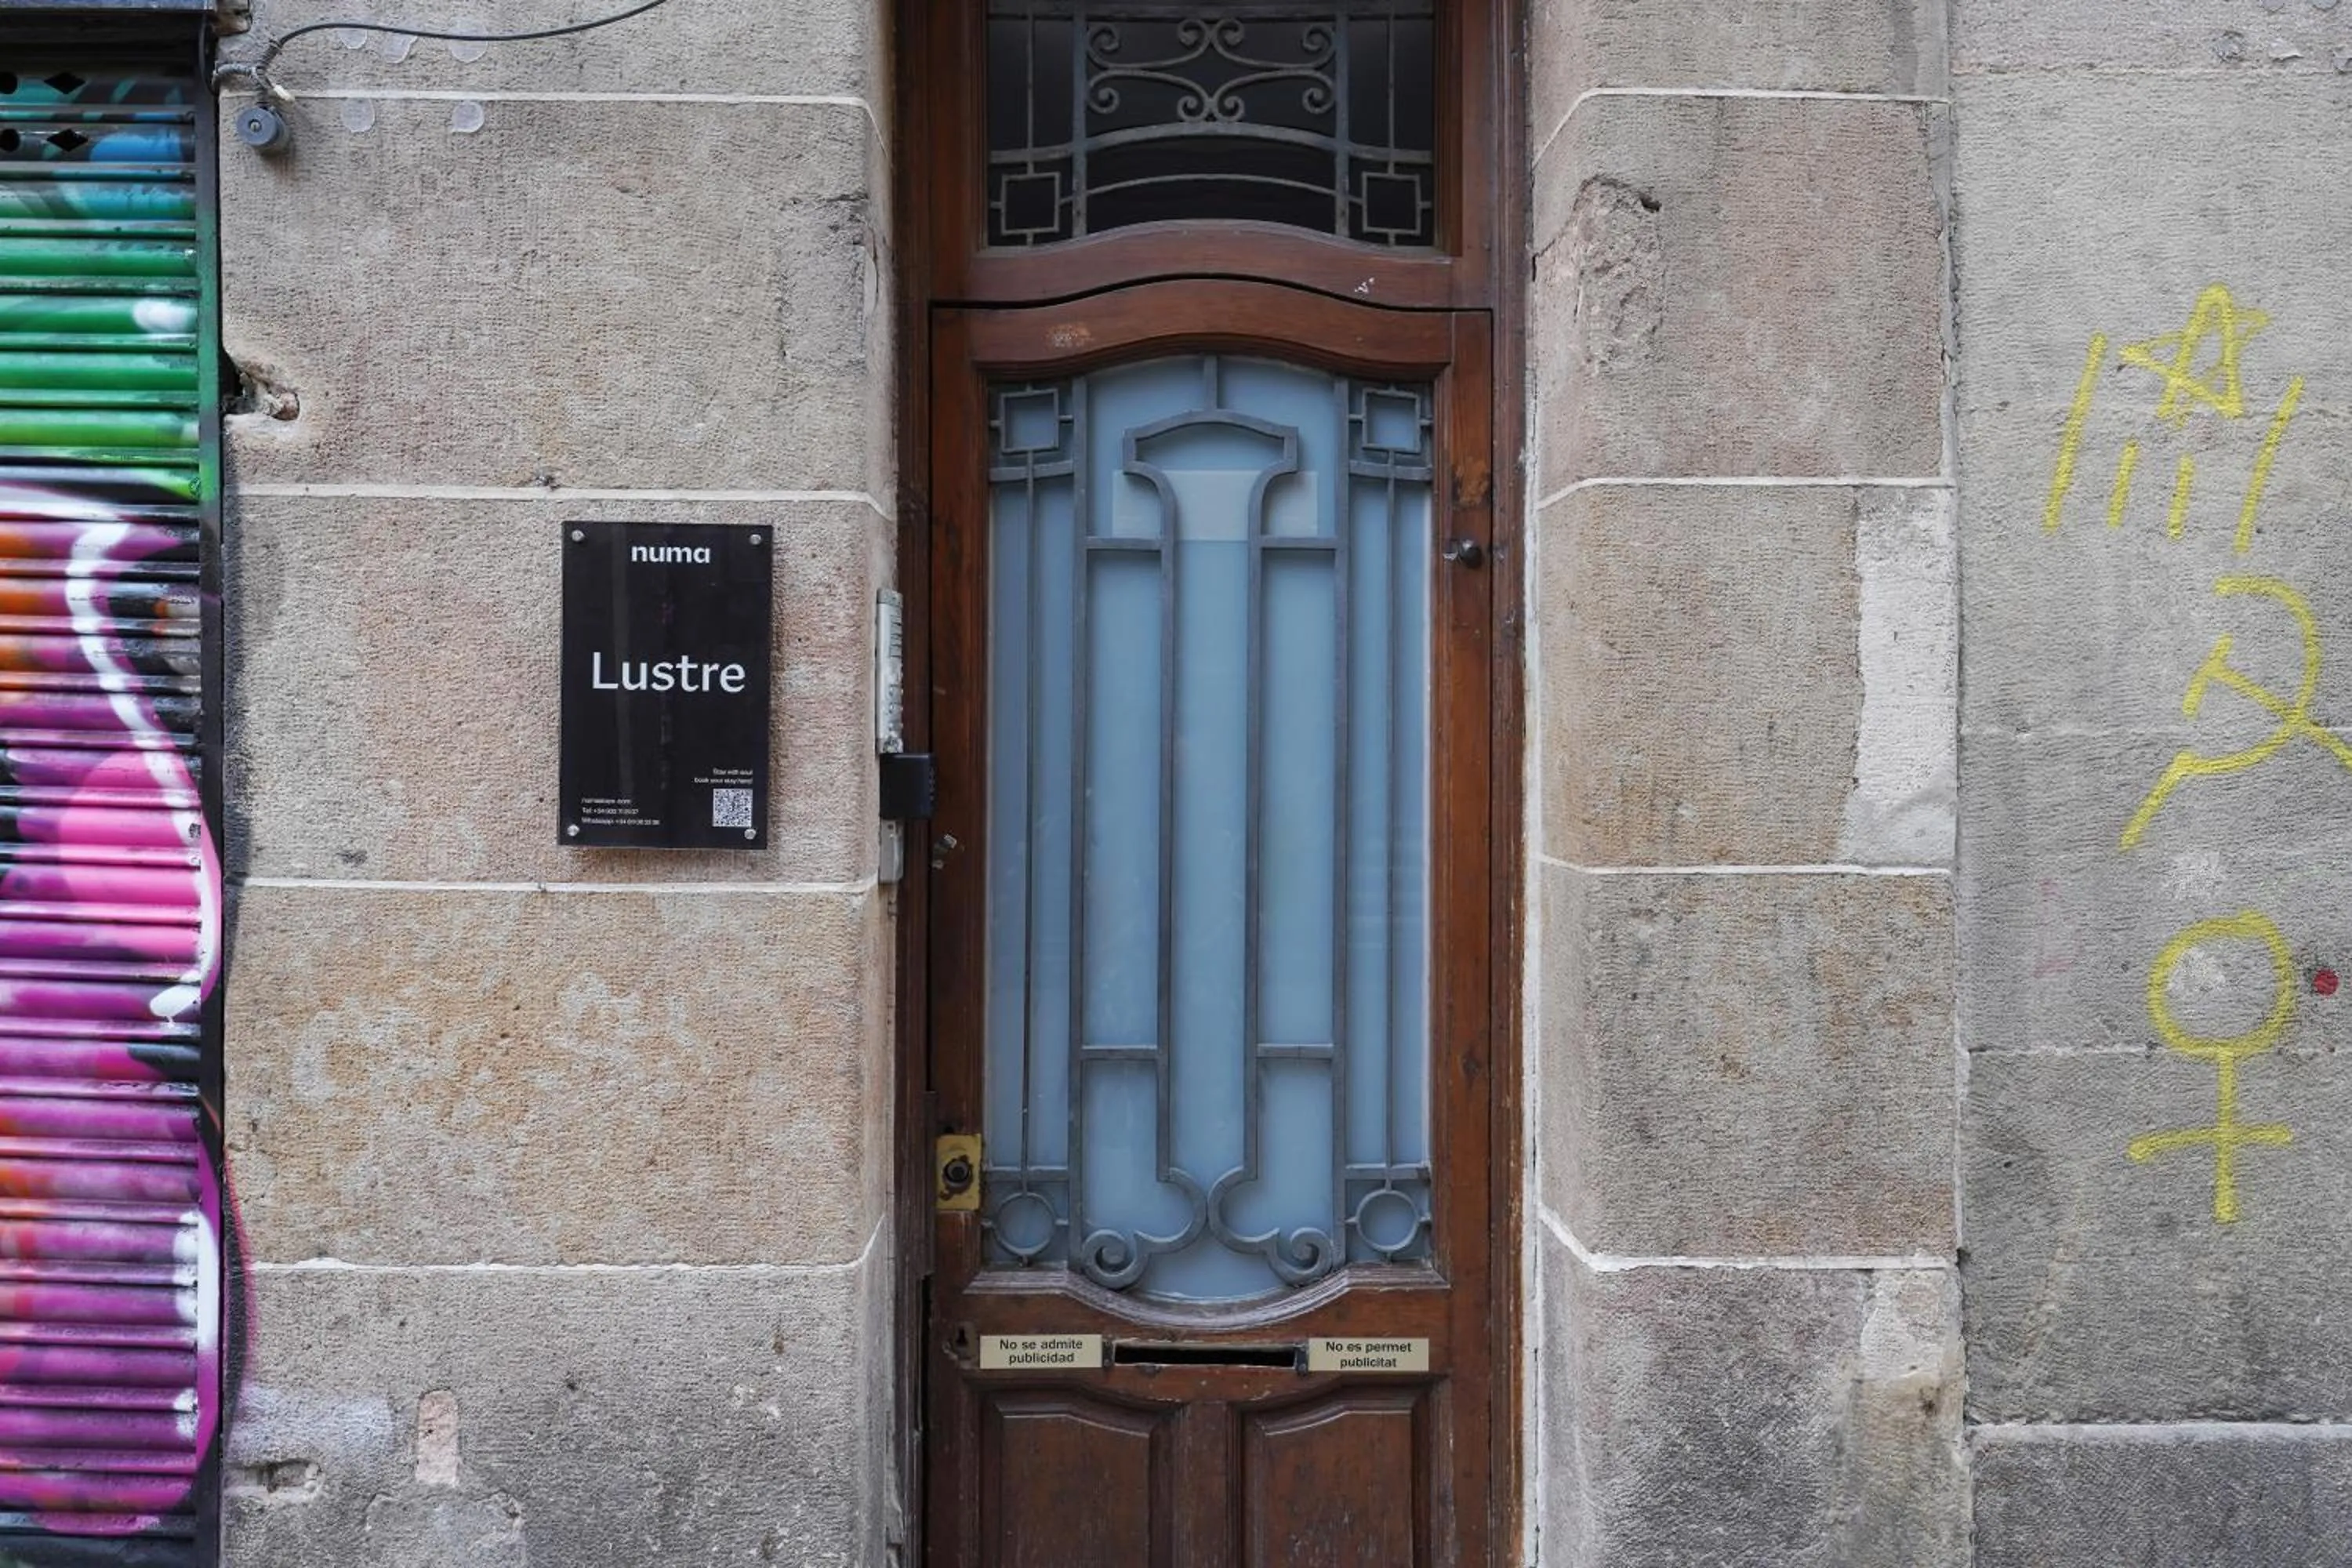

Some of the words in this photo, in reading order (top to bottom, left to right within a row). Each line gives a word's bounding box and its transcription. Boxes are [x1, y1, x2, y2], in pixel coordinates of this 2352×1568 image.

[630, 546, 711, 564] numa
[592, 652, 746, 693] Lustre
[1000, 1338, 1017, 1349] No
[1022, 1341, 1036, 1349] se
[1040, 1338, 1083, 1349] admite
[1326, 1341, 1343, 1352] No
[1346, 1343, 1363, 1352] es
[1365, 1341, 1412, 1354] permet
[1009, 1352, 1075, 1365] publicidad
[1340, 1357, 1397, 1370] publicitat
